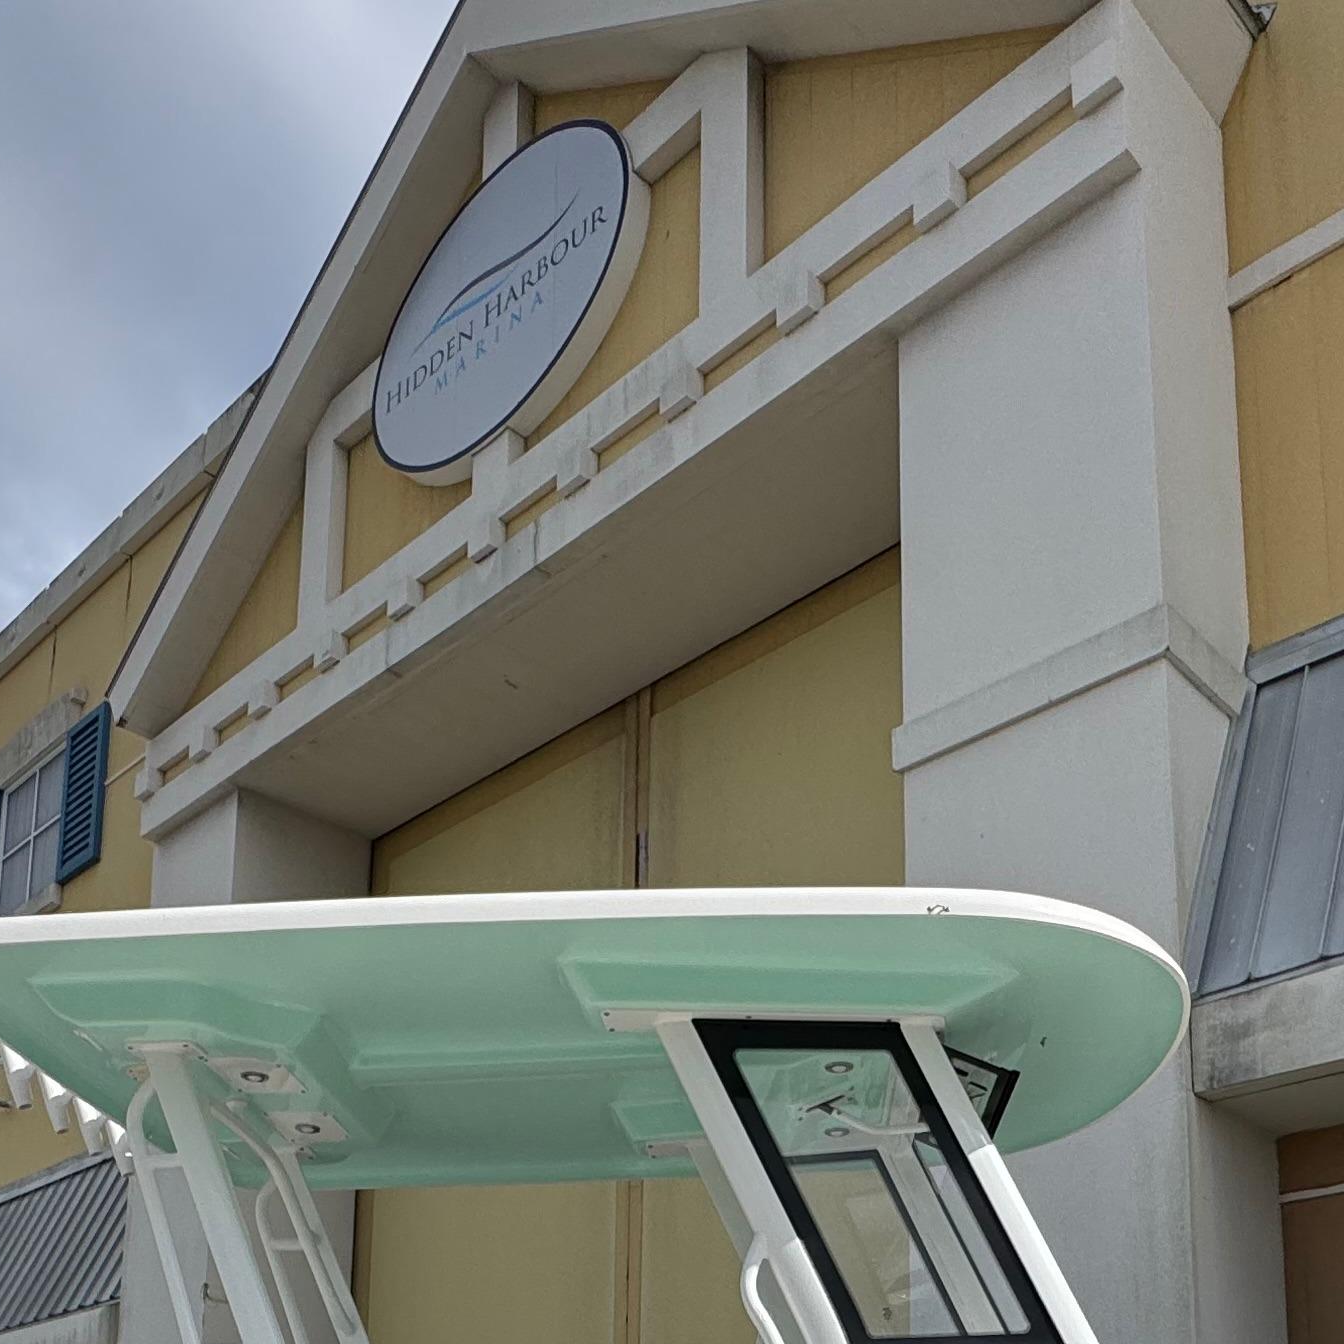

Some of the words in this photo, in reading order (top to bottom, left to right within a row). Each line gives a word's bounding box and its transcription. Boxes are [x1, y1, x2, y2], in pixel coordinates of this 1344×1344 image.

[385, 320, 474, 415] HIDDEN
[483, 206, 608, 328] HARBOUR
[434, 291, 544, 394] MARINA
